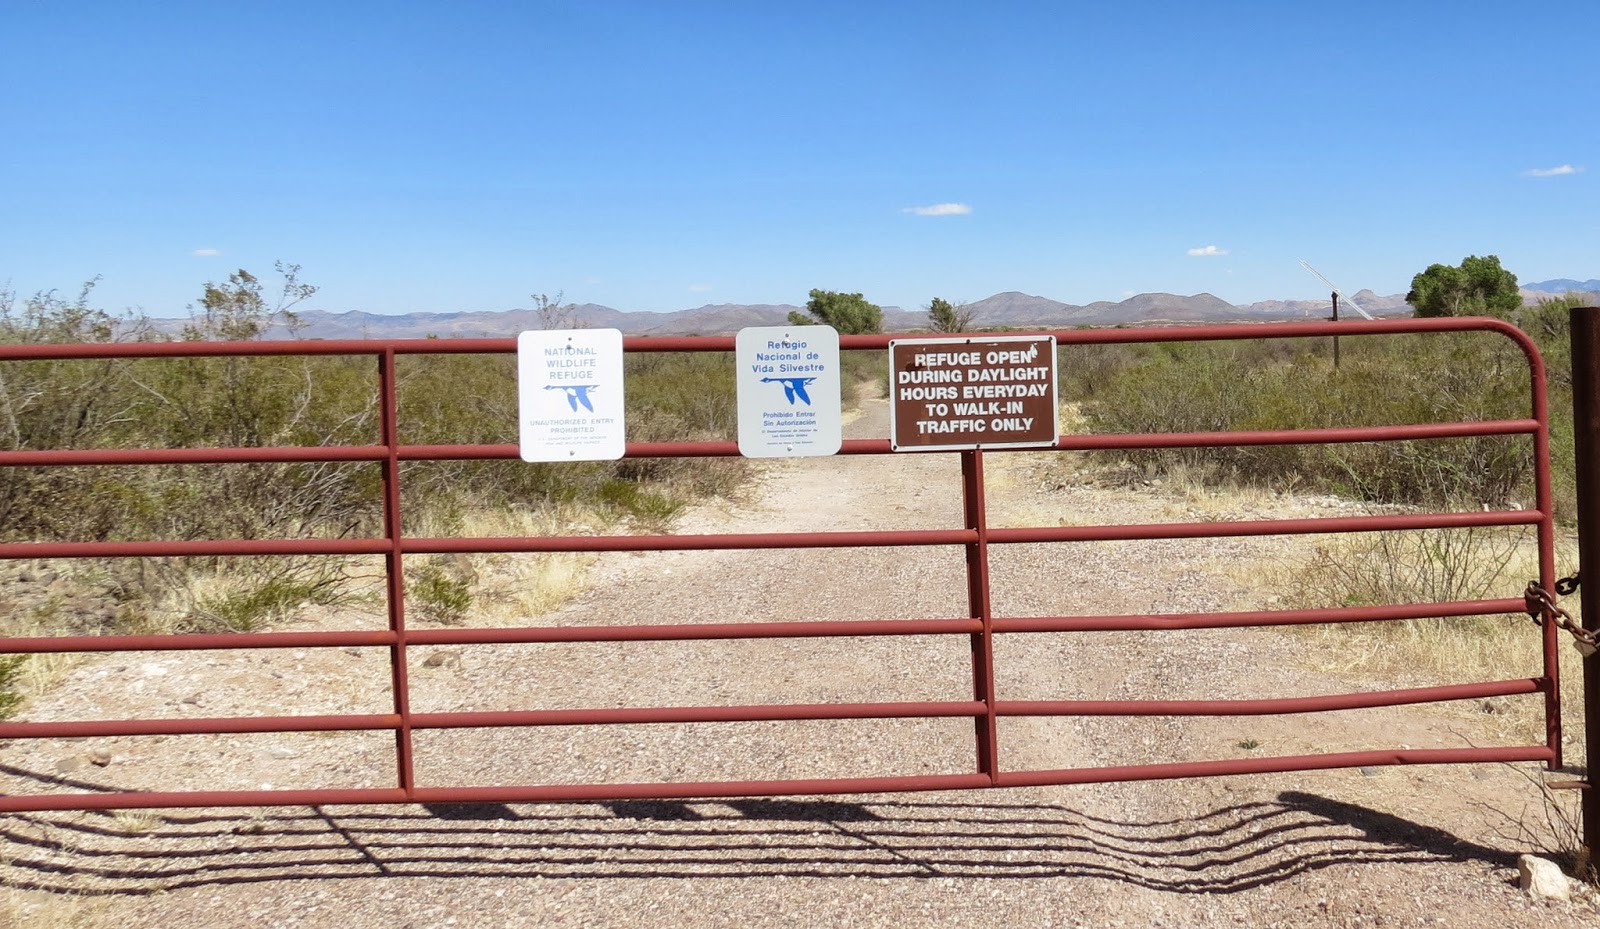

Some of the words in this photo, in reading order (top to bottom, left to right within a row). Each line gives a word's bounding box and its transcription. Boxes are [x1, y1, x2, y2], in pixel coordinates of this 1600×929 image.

[767, 341, 807, 350] Refugio
[544, 347, 597, 356] NATIONAL
[756, 352, 801, 361] Nacional
[806, 352, 819, 360] de
[914, 352, 981, 367] REFUGE
[986, 350, 1032, 365] OPEN
[546, 359, 597, 368] WILDLIFE
[752, 365, 774, 373] Vida
[779, 364, 824, 372] Silvestre
[549, 371, 593, 380] REFUGE
[899, 370, 963, 384] DURING
[968, 367, 1048, 382] DAYLIGHT
[900, 386, 958, 401] HOURS
[963, 384, 1048, 399] EVERYDAY
[925, 403, 948, 417] TO
[953, 401, 1024, 416] WALK-IN
[916, 419, 986, 434] TRAFFIC
[991, 417, 1034, 432] ONLY
